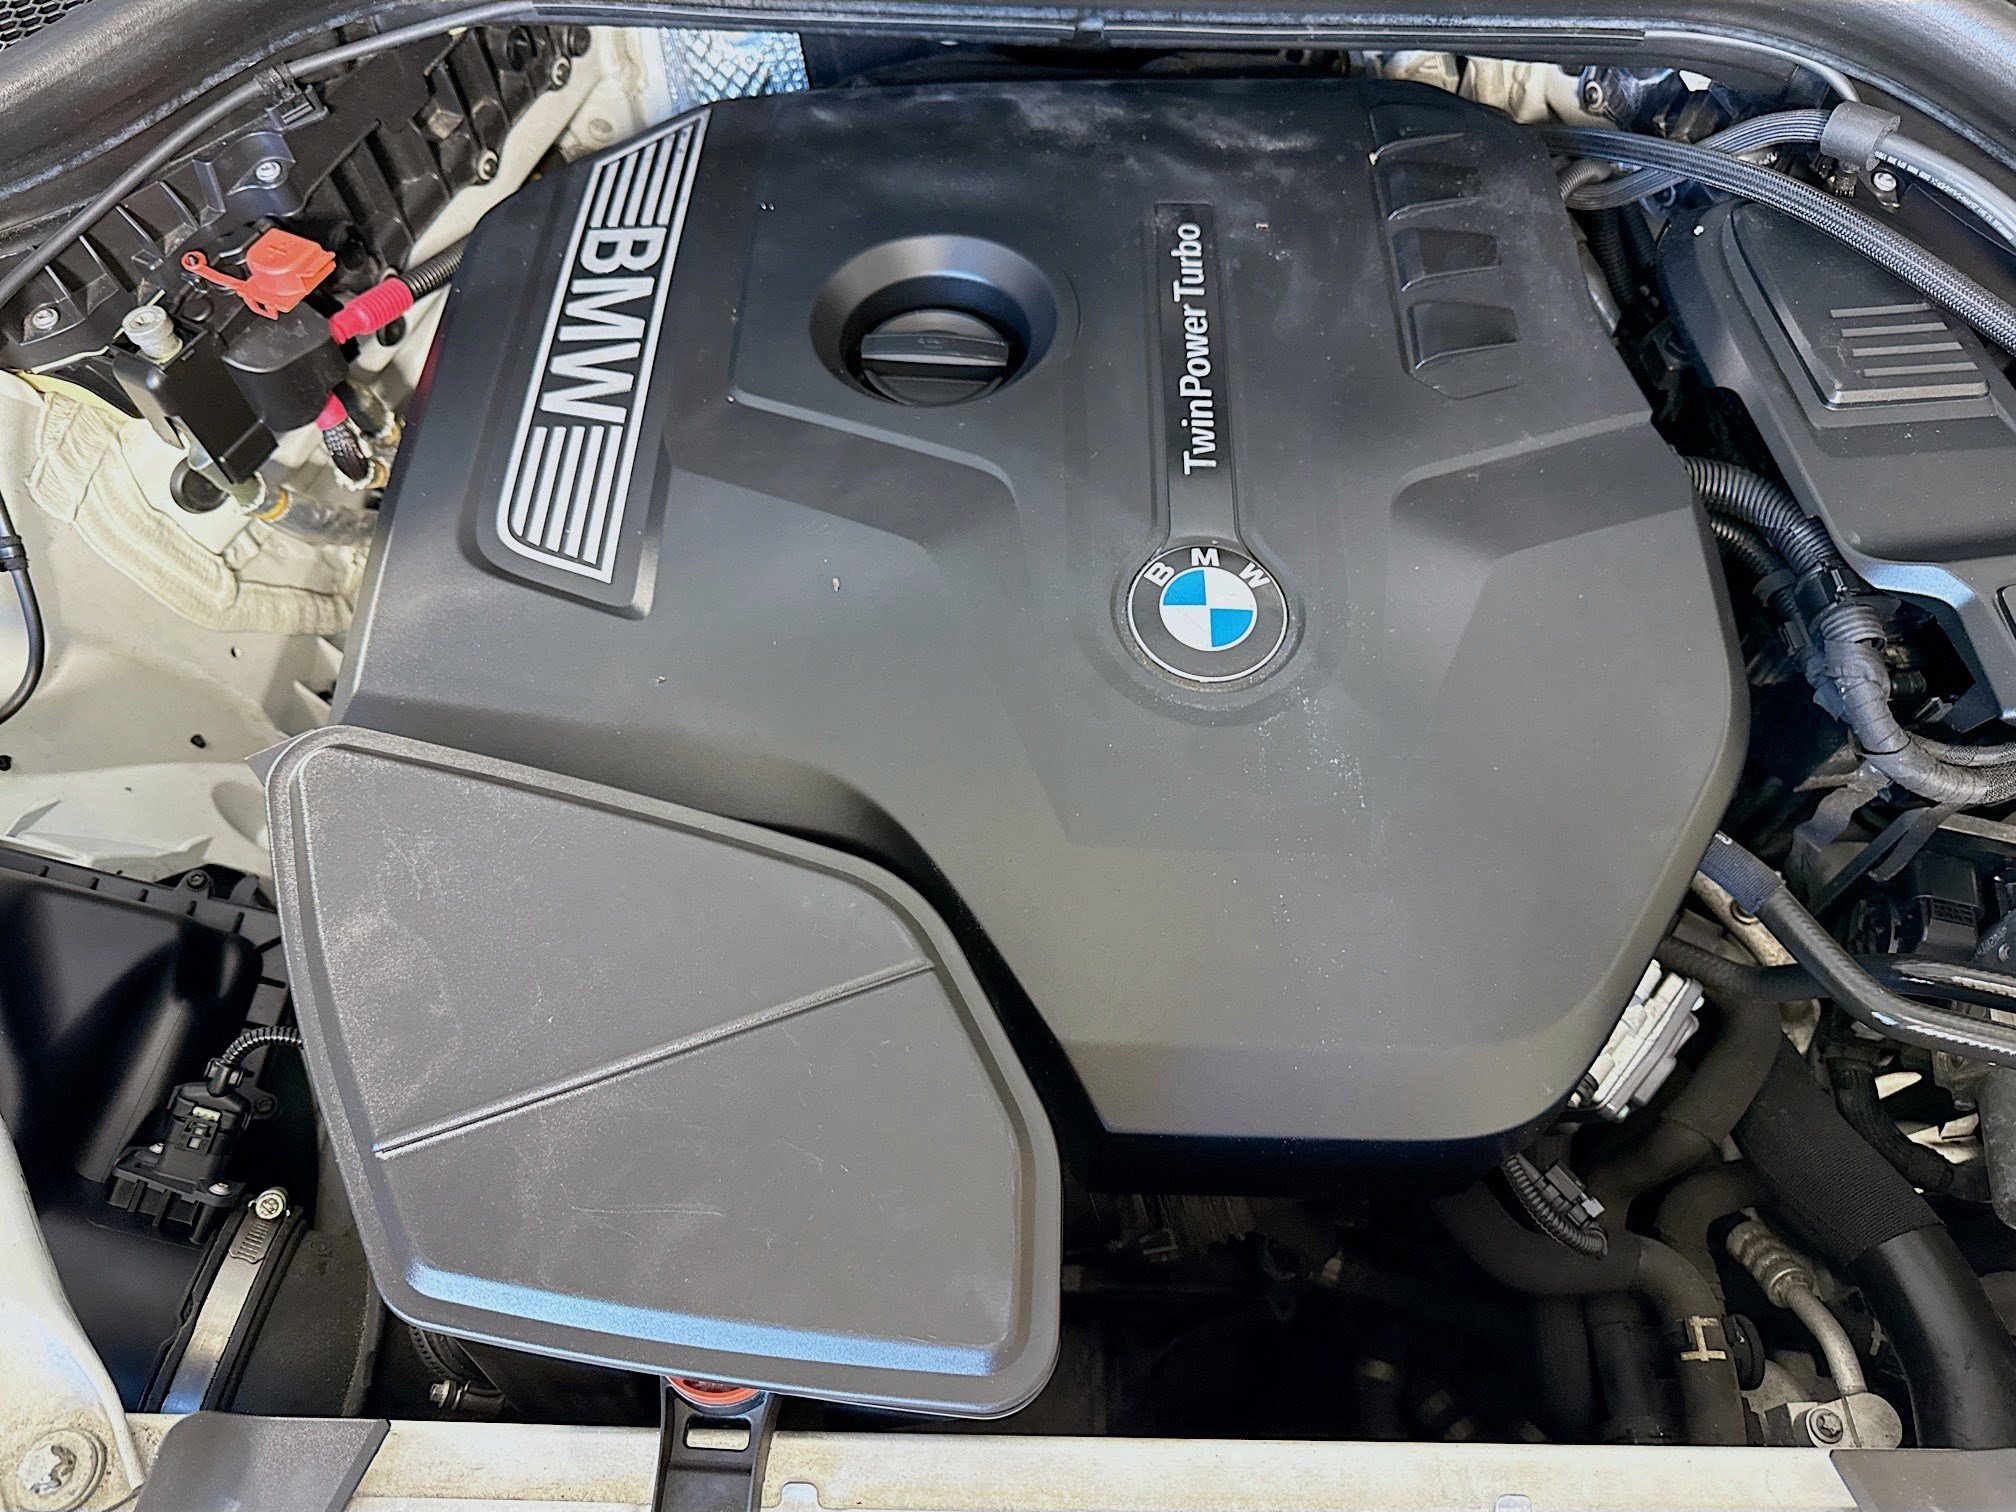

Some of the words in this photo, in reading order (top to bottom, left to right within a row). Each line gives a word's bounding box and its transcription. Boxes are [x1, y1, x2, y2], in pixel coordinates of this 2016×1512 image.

[1171, 222, 1205, 302] Turbo
[540, 227, 668, 424] BMW
[1179, 303, 1217, 475] TwinPower
[1143, 547, 1271, 589] BMW
